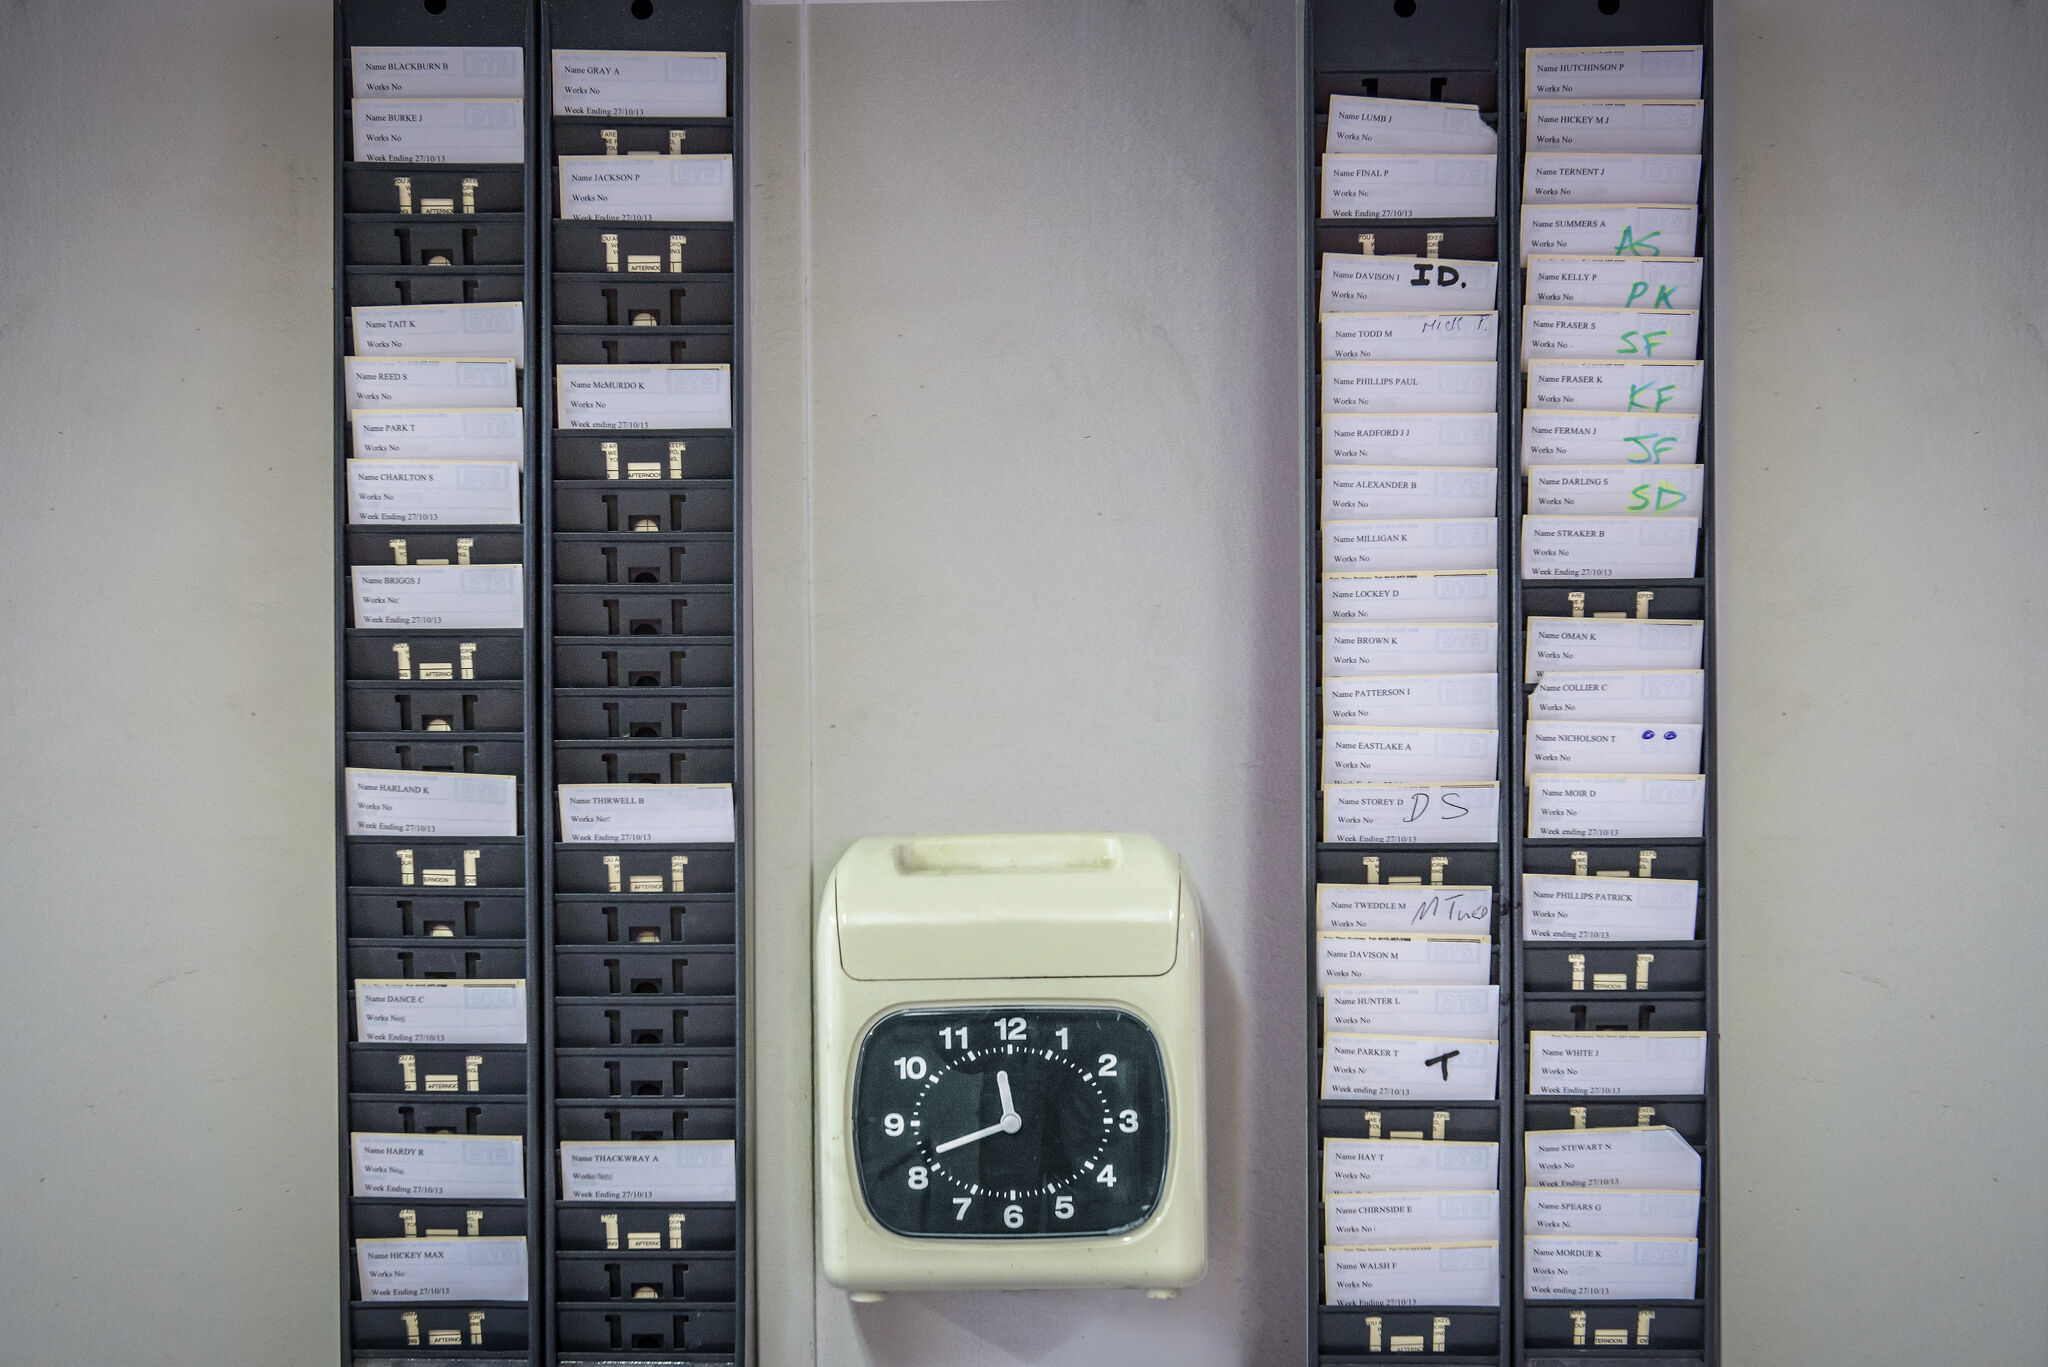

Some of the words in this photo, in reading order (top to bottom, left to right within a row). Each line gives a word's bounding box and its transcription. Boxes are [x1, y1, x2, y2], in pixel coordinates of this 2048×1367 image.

[365, 63, 387, 71] Name
[388, 62, 441, 71] BLACKBURN
[442, 62, 449, 70] B
[564, 66, 586, 74] Name
[586, 66, 612, 75] GRAY
[1559, 63, 1618, 72] HUTCHINSON
[1619, 63, 1625, 71] P
[365, 114, 387, 122] Name
[388, 114, 417, 122] BURKE
[418, 114, 423, 122] J
[1338, 111, 1360, 121] Name
[1361, 113, 1387, 123] LUMB
[1388, 115, 1392, 123] J
[1537, 115, 1559, 123] Name
[1560, 115, 1594, 124] HICKEY
[1595, 116, 1604, 124] M
[1605, 116, 1609, 124] J
[571, 174, 593, 182] Name
[594, 173, 633, 182] JACKSON
[1333, 169, 1355, 177] Name
[1356, 169, 1382, 177] FINAL
[1383, 169, 1389, 177] P
[1532, 220, 1554, 228] Name
[1555, 220, 1598, 228] SUMMERS
[1599, 220, 1606, 228] A
[1538, 273, 1560, 281] Name
[1561, 273, 1590, 281] KELLY
[1591, 273, 1598, 281] P
[387, 320, 408, 328] TAIT
[409, 320, 416, 328] K
[1532, 320, 1554, 328] Name
[1555, 320, 1589, 330] FRASER
[1590, 322, 1596, 330] S
[1335, 330, 1357, 338] Name
[1358, 330, 1383, 338] TODD
[1384, 330, 1393, 338] M
[1614, 330, 1673, 358] SF
[593, 381, 637, 390] McMURDO
[638, 382, 645, 390] K
[1356, 377, 1394, 386] PHILLIPS
[1395, 378, 1418, 386] PAUL
[1626, 380, 1679, 413] KF
[1356, 429, 1399, 437] RADFORD
[1400, 429, 1404, 437] J
[1406, 429, 1410, 437] J
[1622, 432, 1679, 465] JF
[358, 473, 379, 481] Name
[380, 473, 427, 482] CHARLTON
[428, 474, 434, 482] S
[1561, 477, 1602, 486] DARLING
[1603, 478, 1609, 486] S
[1333, 480, 1354, 488] Name
[1355, 480, 1409, 489] ALEXANDER
[1410, 481, 1417, 489] B
[1625, 481, 1688, 517] SD
[1356, 534, 1399, 543] MILLIGAN
[1401, 534, 1408, 542] K
[1534, 529, 1556, 537] Name
[1556, 529, 1597, 537] STRAKER
[1598, 530, 1605, 538] B
[1531, 568, 1553, 576] Week
[1554, 568, 1580, 578] Ending
[1580, 568, 1613, 576] 27/10/13
[1355, 590, 1391, 598] LOCKEY
[1392, 590, 1399, 598] D
[1334, 636, 1356, 644] Name
[1357, 637, 1390, 645] BROWN
[1391, 637, 1398, 645] K
[1354, 688, 1405, 698] PATTERSON
[1407, 688, 1410, 696] I
[1335, 741, 1357, 749] Name
[1358, 742, 1403, 751] EASTLAKE
[1404, 743, 1412, 751] A
[357, 783, 379, 791] Name
[379, 784, 422, 794] HARLAND
[422, 786, 430, 794] K
[1542, 789, 1564, 797] Name
[1564, 789, 1588, 797] MOIR
[1589, 790, 1597, 798] D
[1361, 798, 1395, 806] STOREY
[1397, 798, 1404, 806] D
[357, 821, 378, 830] Week
[379, 822, 404, 833] Ending
[404, 824, 436, 833] 27/10/13
[1533, 890, 1555, 899] Name
[1555, 891, 1594, 900] PHILLIPS
[1595, 893, 1633, 902] PATRICK
[1331, 901, 1353, 909] Name
[1354, 901, 1396, 910] TWEDDLE
[1398, 902, 1406, 910] M
[1327, 950, 1348, 958] Name
[1349, 950, 1389, 959] DAVISON
[1390, 952, 1398, 960] M
[1357, 997, 1393, 1005] HUNTER
[1395, 997, 1401, 1005] L
[994, 1017, 1026, 1040] 12
[939, 1027, 967, 1050] 11
[1056, 1027, 1068, 1050] 1
[1334, 1046, 1356, 1055] Name
[1357, 1048, 1391, 1057] PARKER
[1393, 1049, 1399, 1057] T
[894, 1056, 927, 1079] 10
[1099, 1054, 1117, 1076] 2
[1424, 1050, 1460, 1082] T
[884, 1113, 904, 1136] 9
[1119, 1109, 1138, 1133] 3
[594, 1154, 651, 1162] THACKWRAY
[652, 1155, 659, 1163] A
[1335, 1152, 1356, 1161] Name
[1358, 1153, 1377, 1161] HAY
[908, 1166, 928, 1190] 8
[1097, 1164, 1117, 1187] 4
[953, 1198, 971, 1220] 7
[1055, 1196, 1074, 1219] 5
[1004, 1205, 1023, 1228] 6
[390, 1251, 422, 1259] HICKEY
[424, 1251, 444, 1259] MAX
[1533, 1248, 1555, 1257] Name
[1556, 1249, 1593, 1257] MORDUE
[1595, 1250, 1602, 1258] K
[371, 1288, 392, 1296] Week
[393, 1288, 418, 1297] Ending
[419, 1287, 450, 1295] 27/10/13
